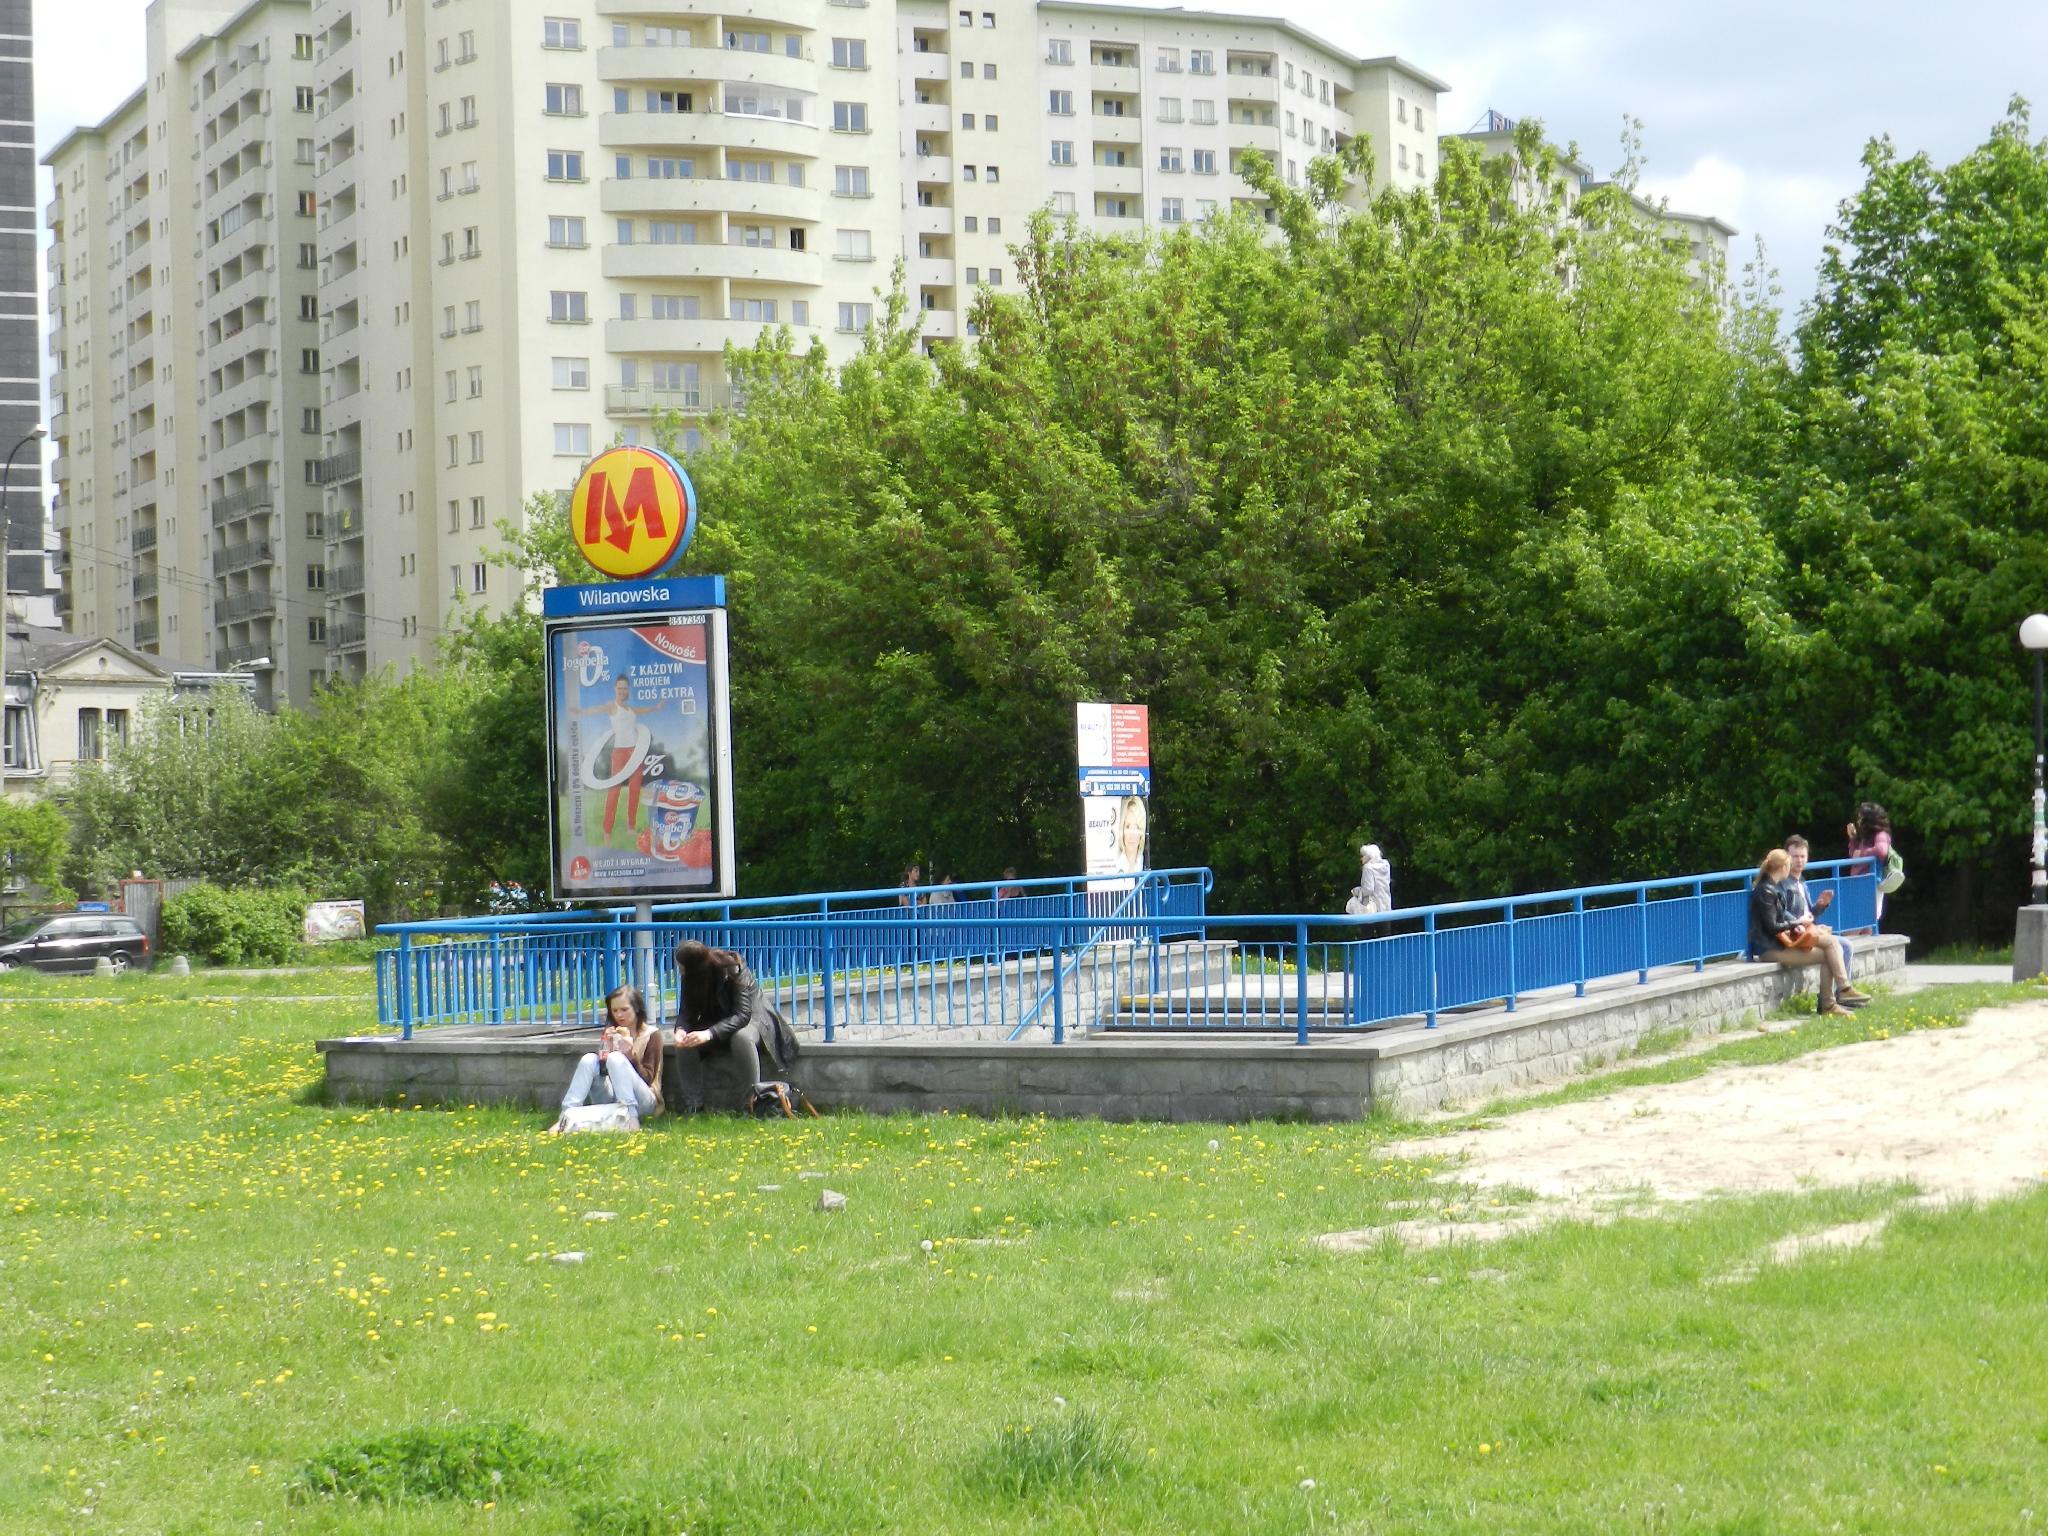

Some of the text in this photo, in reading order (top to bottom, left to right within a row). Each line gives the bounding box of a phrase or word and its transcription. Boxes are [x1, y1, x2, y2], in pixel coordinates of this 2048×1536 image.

[579, 586, 670, 606] Wilanowska
[654, 632, 697, 659] Nowość
[562, 654, 609, 671] Jogobella
[630, 663, 683, 675] Z KAŻDYM
[633, 676, 671, 687] KROKIEM
[637, 687, 695, 700] COŚ EXTRA
[1088, 819, 1110, 828] BEAUTY
